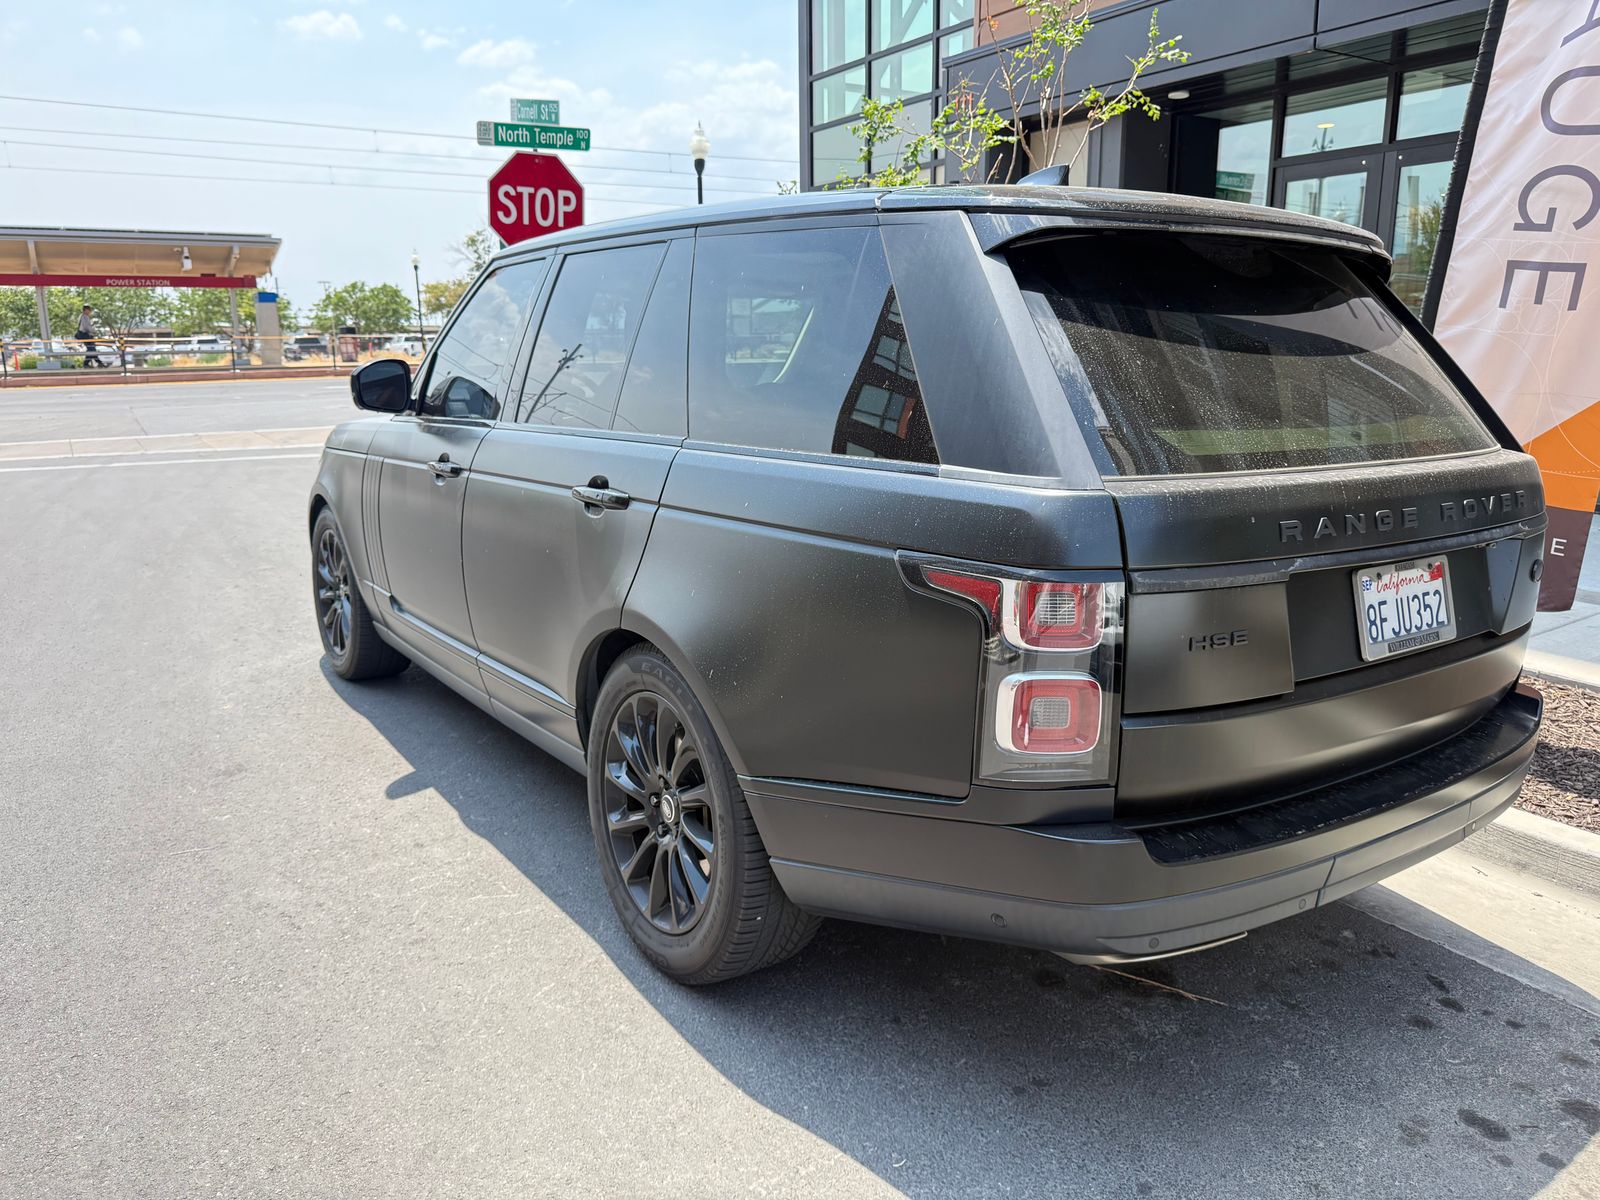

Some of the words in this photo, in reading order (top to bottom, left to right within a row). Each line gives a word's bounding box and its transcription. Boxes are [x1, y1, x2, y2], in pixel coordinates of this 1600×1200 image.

[540, 104, 549, 121] St
[498, 126, 531, 144] North
[534, 128, 574, 147] Temple
[576, 130, 589, 139] 100
[580, 141, 586, 150] N
[497, 184, 577, 228] STOP
[105, 278, 135, 286] POWER
[1279, 507, 1418, 543] RANGE
[1440, 490, 1526, 523] ROVER
[1361, 579, 1373, 592] SEP
[1376, 570, 1430, 595] California
[1366, 589, 1446, 642] 8FJU352
[1188, 629, 1249, 652] HSE
